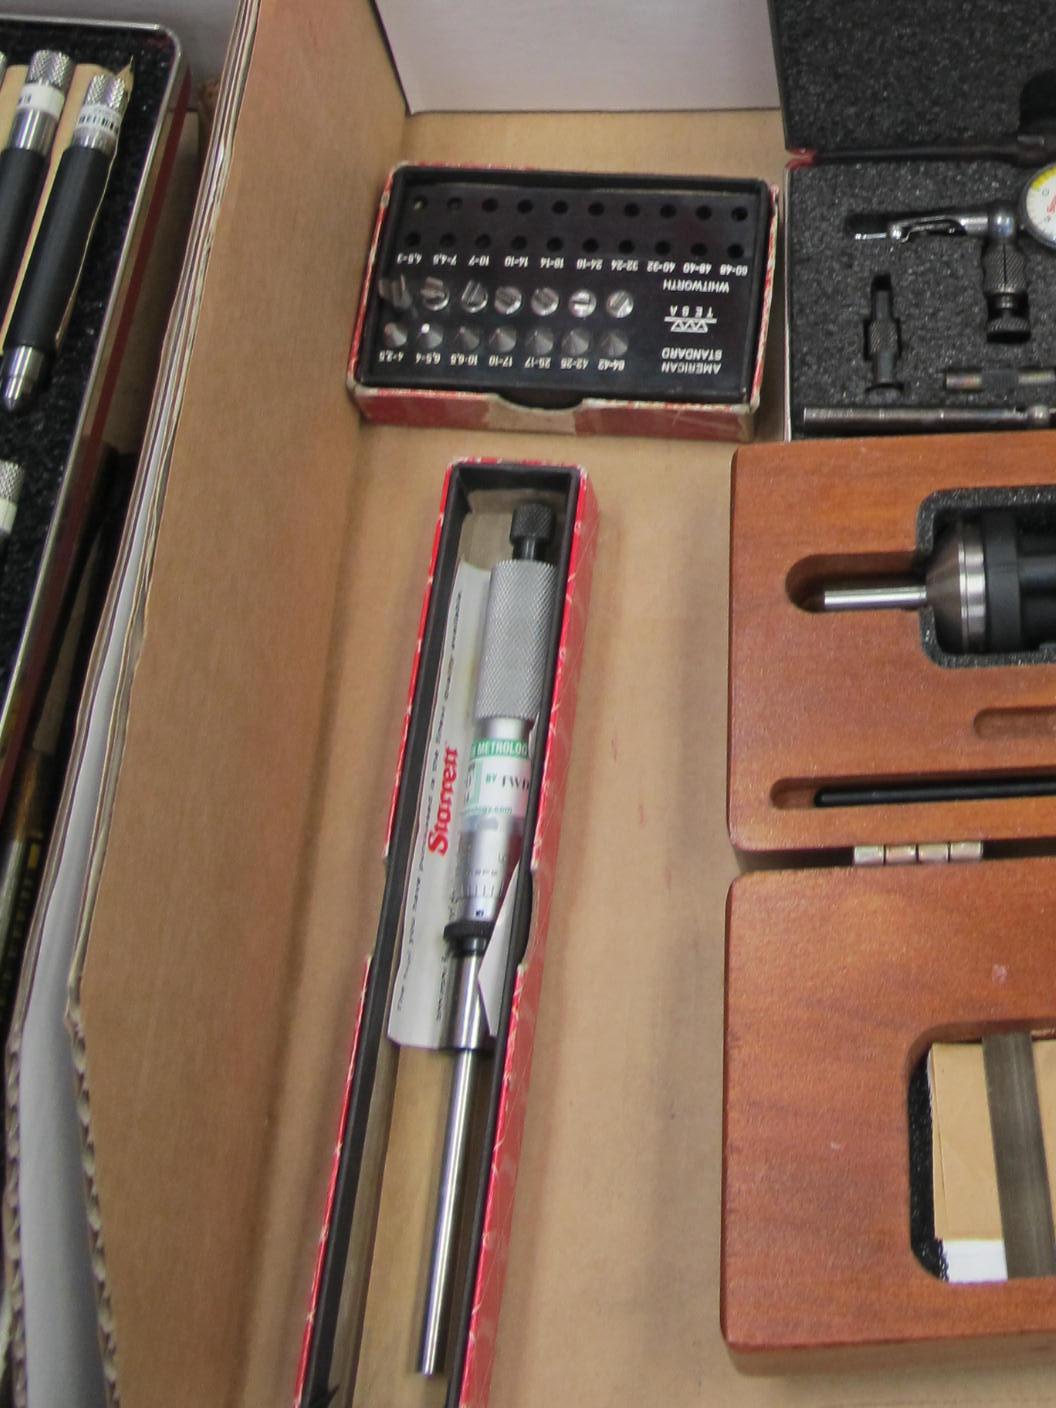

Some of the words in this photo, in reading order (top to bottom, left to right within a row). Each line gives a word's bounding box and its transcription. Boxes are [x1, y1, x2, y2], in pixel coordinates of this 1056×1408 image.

[662, 279, 730, 294] WHITWORTH
[661, 347, 723, 360] STANDARD
[661, 361, 722, 375] AMERICAN
[427, 746, 459, 858] Starrett
